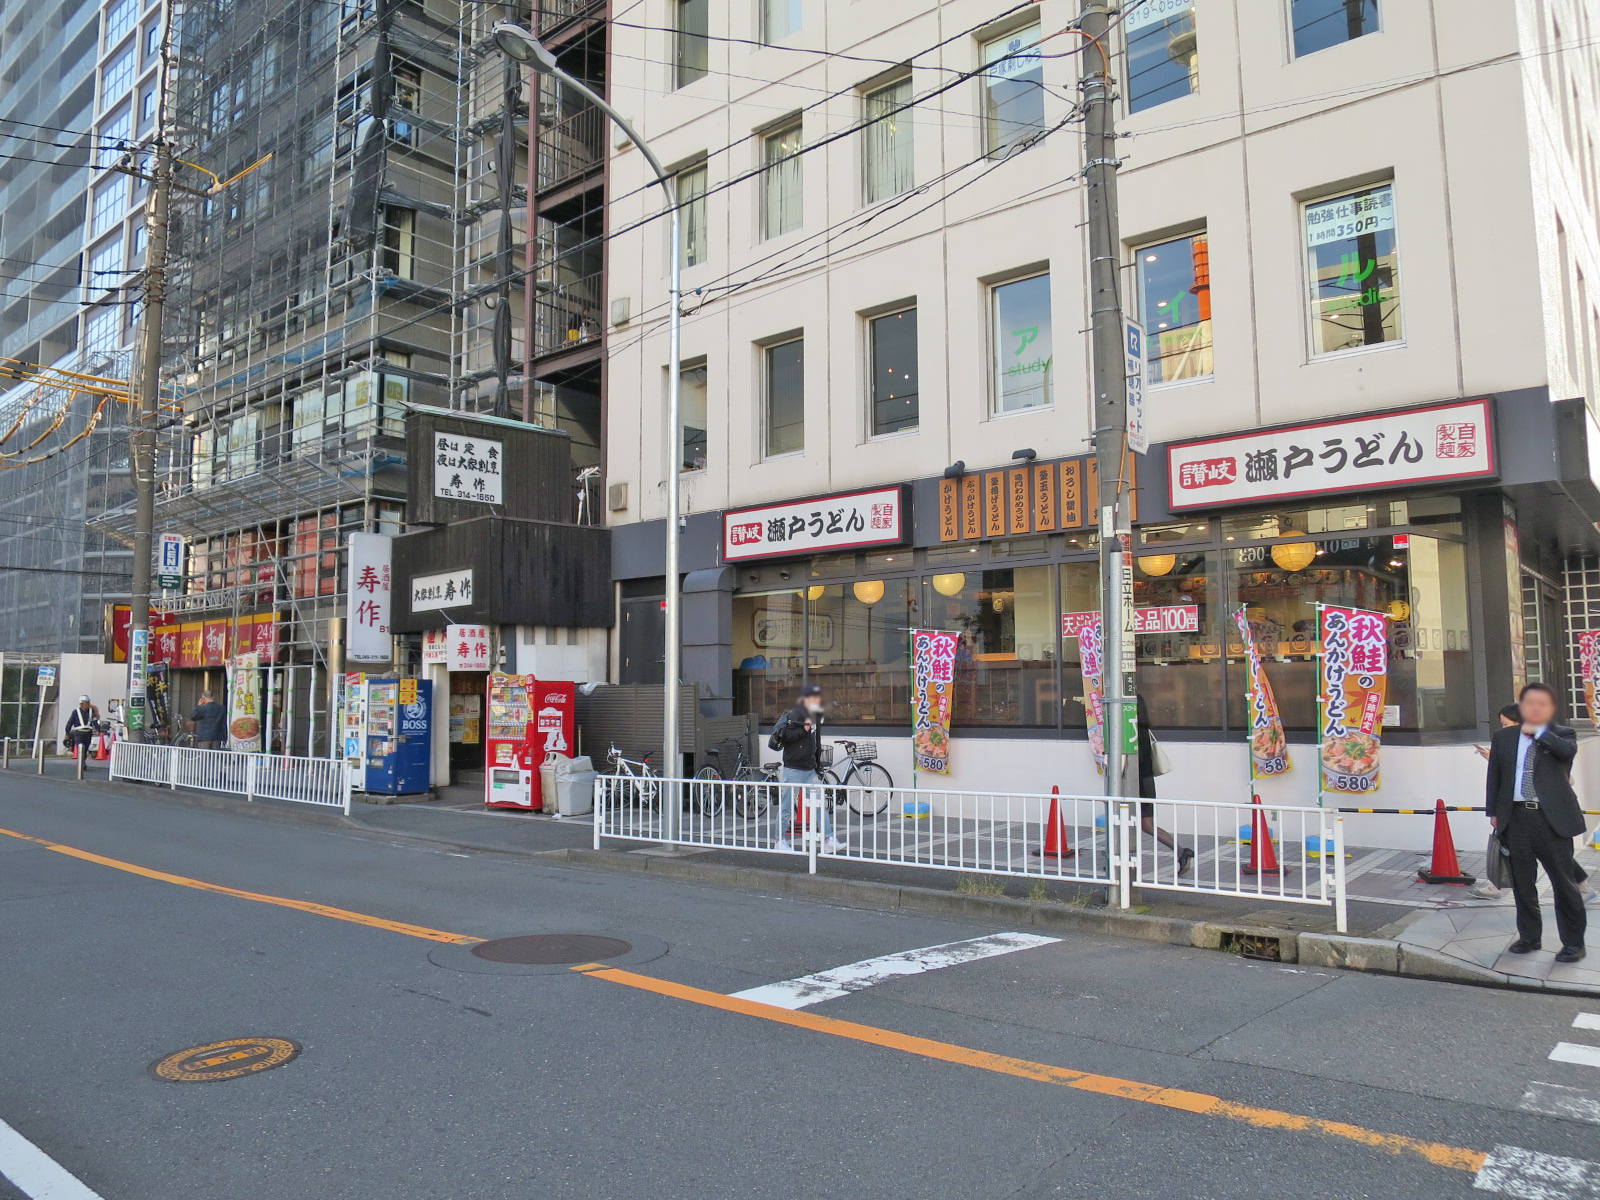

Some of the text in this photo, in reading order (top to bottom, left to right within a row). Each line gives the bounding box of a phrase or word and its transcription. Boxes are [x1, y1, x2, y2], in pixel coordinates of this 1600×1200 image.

[1307, 192, 1392, 226] 勉強仕事読書
[1012, 326, 1039, 356] ア
[1008, 356, 1051, 378] study
[1181, 430, 1424, 487] 讃岐 瀬戸うどん
[449, 473, 486, 493] 寿作
[1065, 466, 1076, 522] おろし醤油
[943, 484, 953, 536] かけうどん
[966, 480, 977, 534] ぶっかけうどん
[731, 507, 865, 544] 讃岐 瀬戸うどん
[167, 543, 176, 566] KEN
[382, 564, 390, 591] 居酒屋
[444, 577, 472, 601] 寿作
[355, 565, 381, 627] 寿作
[1122, 568, 1134, 632] 日立ホーム
[457, 641, 487, 658] 寿作
[459, 628, 485, 638] 居酒屋
[133, 645, 143, 679] 有馬医院
[1326, 613, 1347, 736] あんかけうどん
[544, 692, 567, 704] Coca-Cola
[916, 637, 931, 729] あんかけうどん
[402, 720, 427, 730] BOSS
